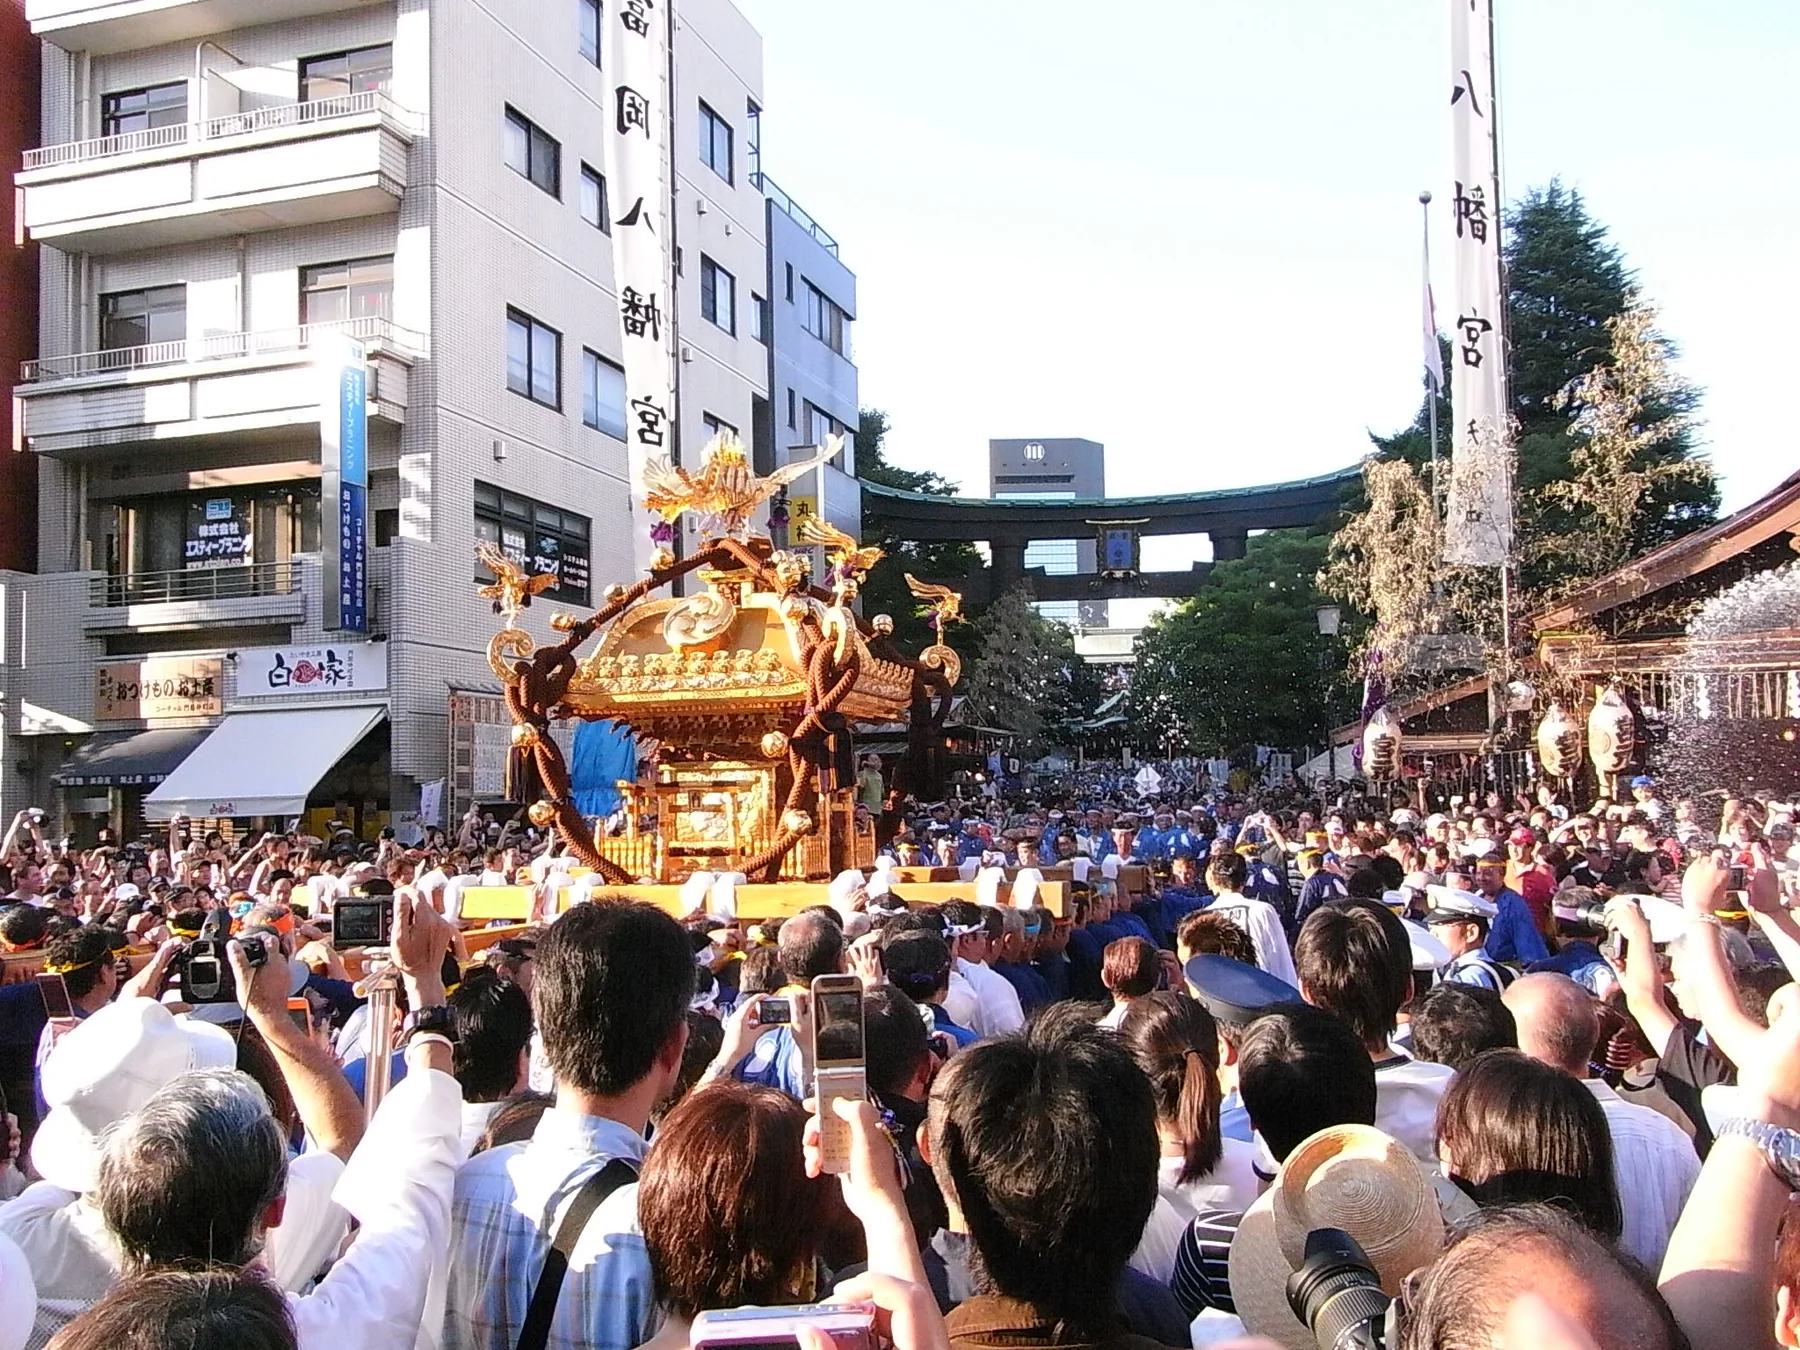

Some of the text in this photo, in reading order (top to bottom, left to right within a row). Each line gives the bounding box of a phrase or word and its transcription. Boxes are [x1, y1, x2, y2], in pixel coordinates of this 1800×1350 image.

[1451, 0, 1493, 369] 八幡宮
[198, 521, 240, 538] 株式会社
